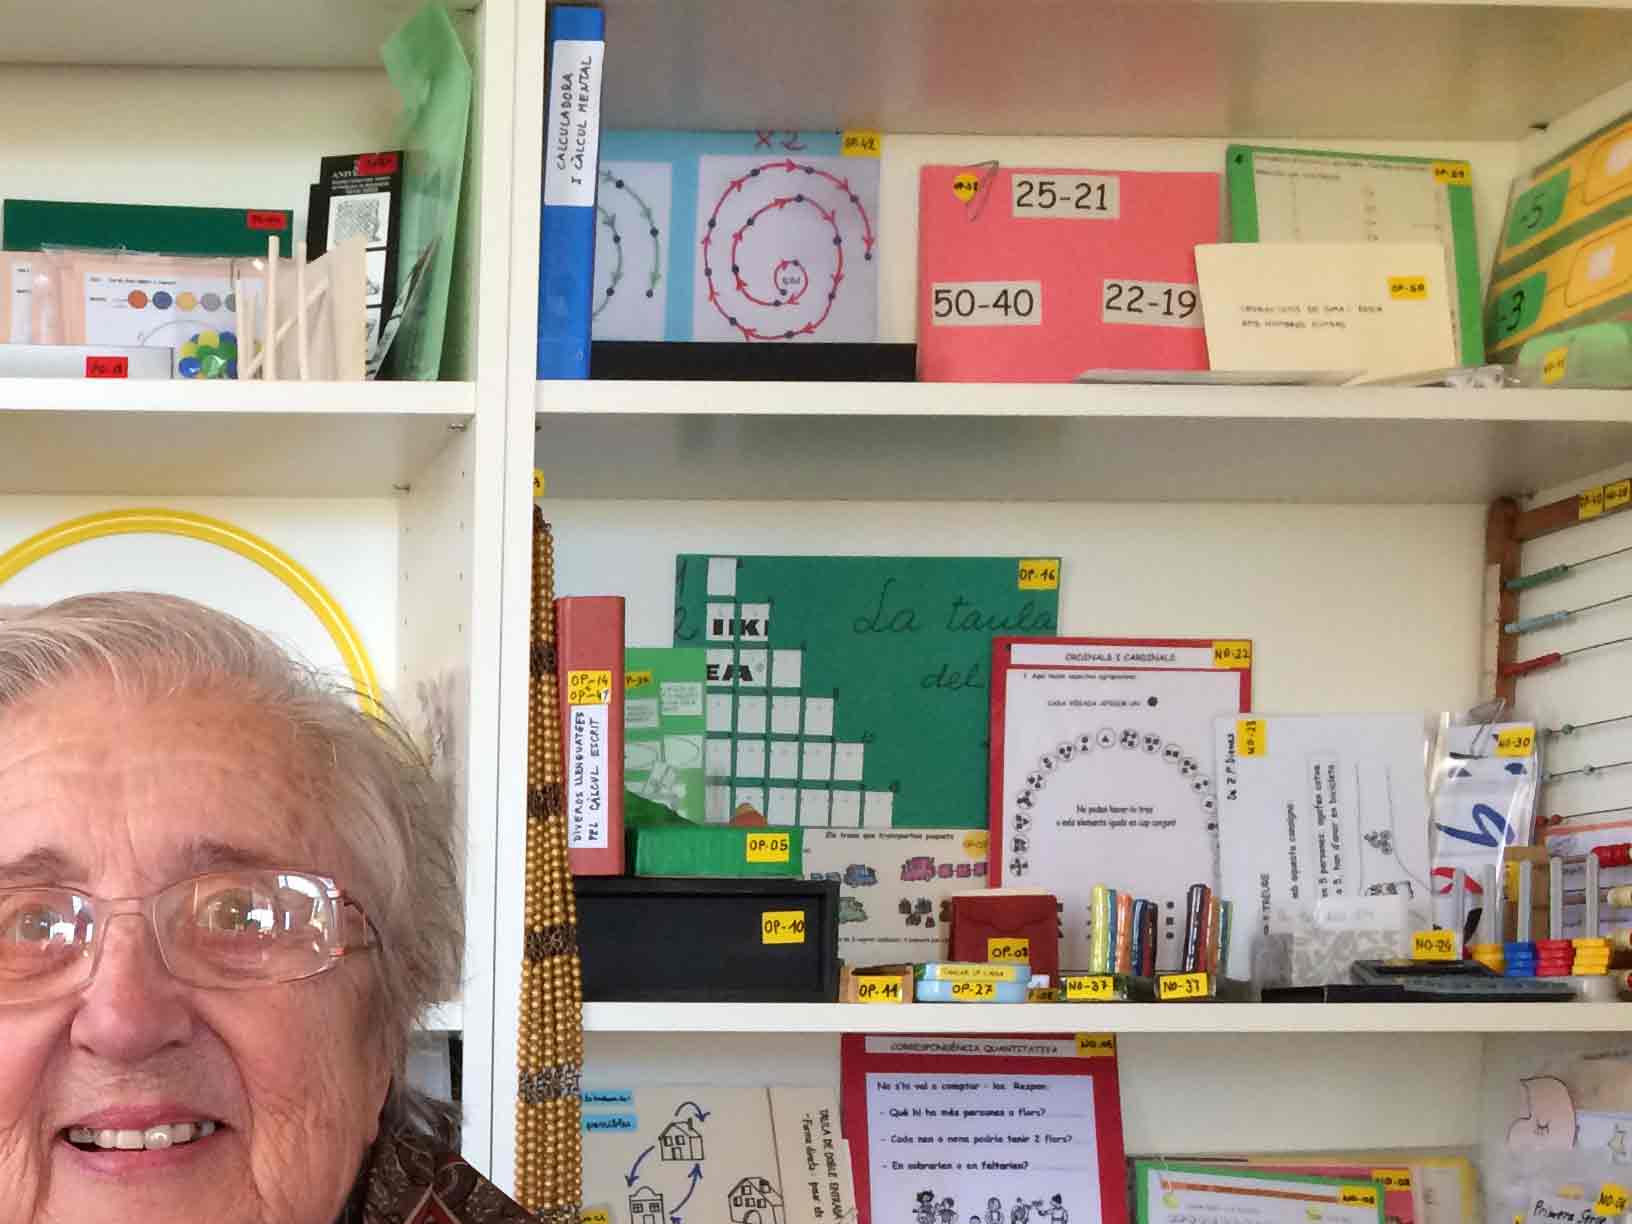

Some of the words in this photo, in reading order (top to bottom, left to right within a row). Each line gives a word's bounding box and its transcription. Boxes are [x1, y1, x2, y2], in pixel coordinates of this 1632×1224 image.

[579, 56, 592, 112] MENTAL
[557, 73, 573, 170] CALCULADORA
[1015, 180, 1108, 211] 25-21
[934, 288, 1034, 317] 50-40
[1105, 283, 1198, 319] 22-19
[853, 577, 919, 633] La
[945, 594, 1058, 632] taula
[920, 663, 986, 691] del
[763, 918, 806, 934] OP-10
[951, 983, 994, 996] OP-27
[877, 1081, 891, 1091] No
[941, 1082, 980, 1093] comptar
[963, 1109, 1005, 1119] persones
